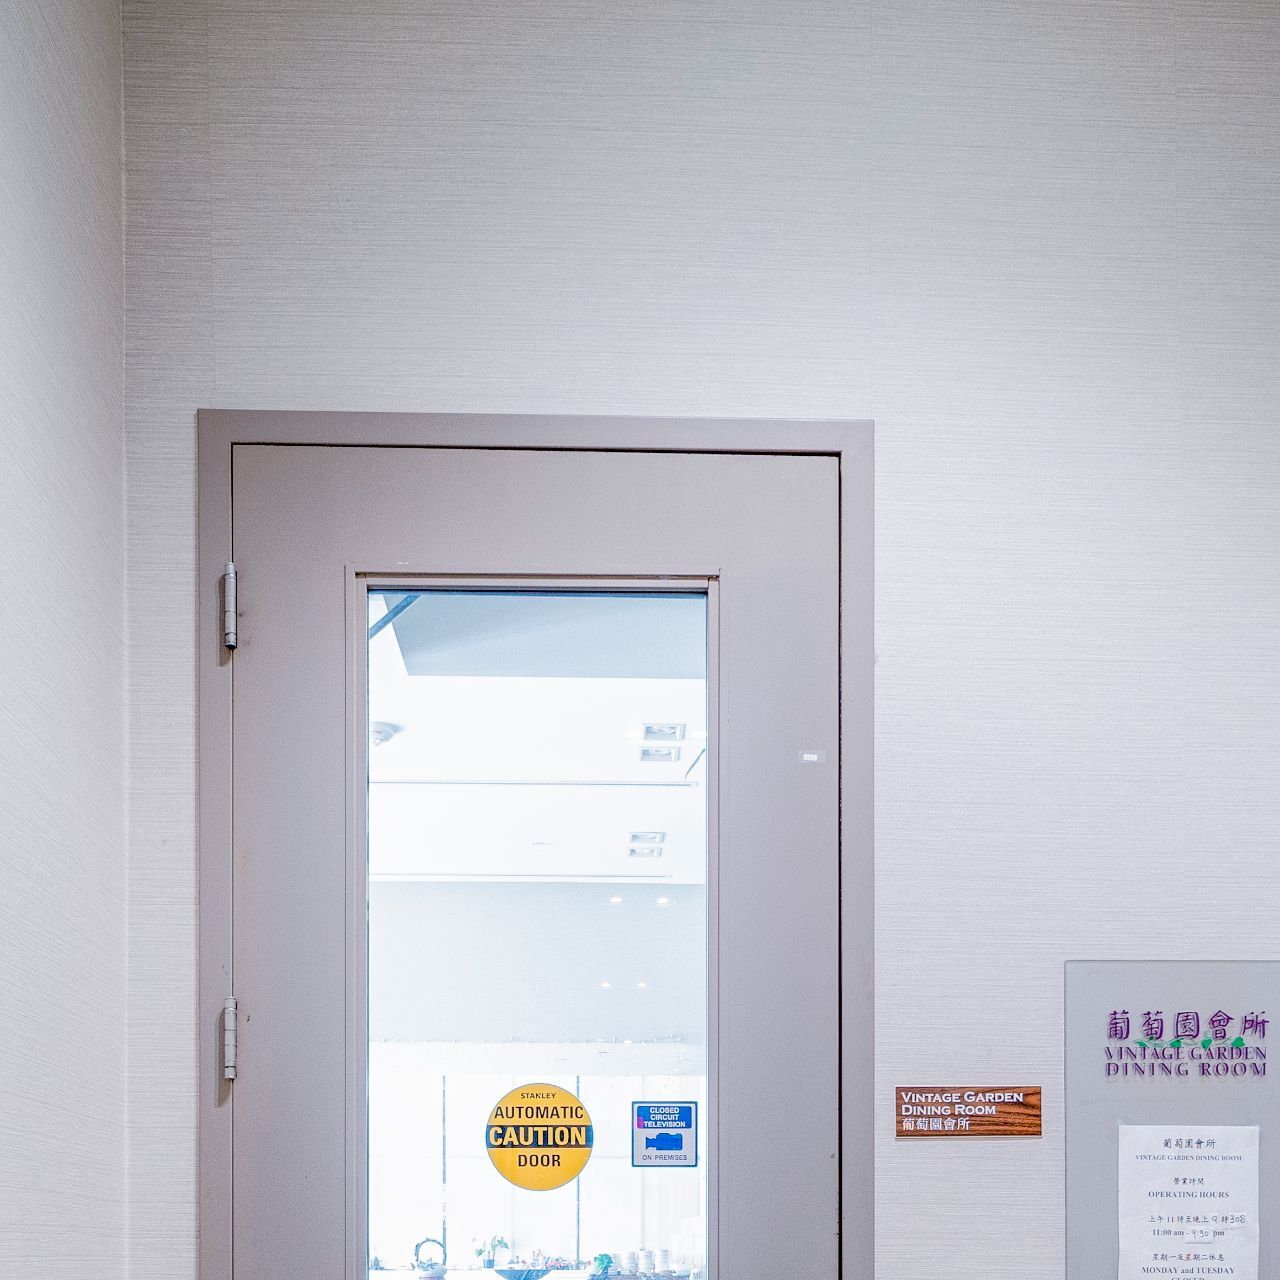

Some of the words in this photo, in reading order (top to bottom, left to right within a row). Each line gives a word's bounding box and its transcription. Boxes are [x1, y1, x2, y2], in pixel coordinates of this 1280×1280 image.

[1107, 1009, 1270, 1041] 葡萄園會所
[1105, 1046, 1185, 1060] VINTAGE
[1189, 1046, 1267, 1060] GARDEN
[1106, 1062, 1189, 1076] DINING
[1200, 1062, 1267, 1076] ROOM
[901, 1091, 961, 1103] VINTAGE
[964, 1091, 1024, 1103] GARDEN
[494, 1106, 584, 1119] AUTOMATIC
[901, 1104, 951, 1115] DINING
[954, 1104, 996, 1115] ROOM
[902, 1117, 970, 1131] 葡萄園會所
[489, 1126, 587, 1146] CAUTION
[518, 1154, 561, 1167] DOOR
[1199, 1191, 1230, 1199] HOURS
